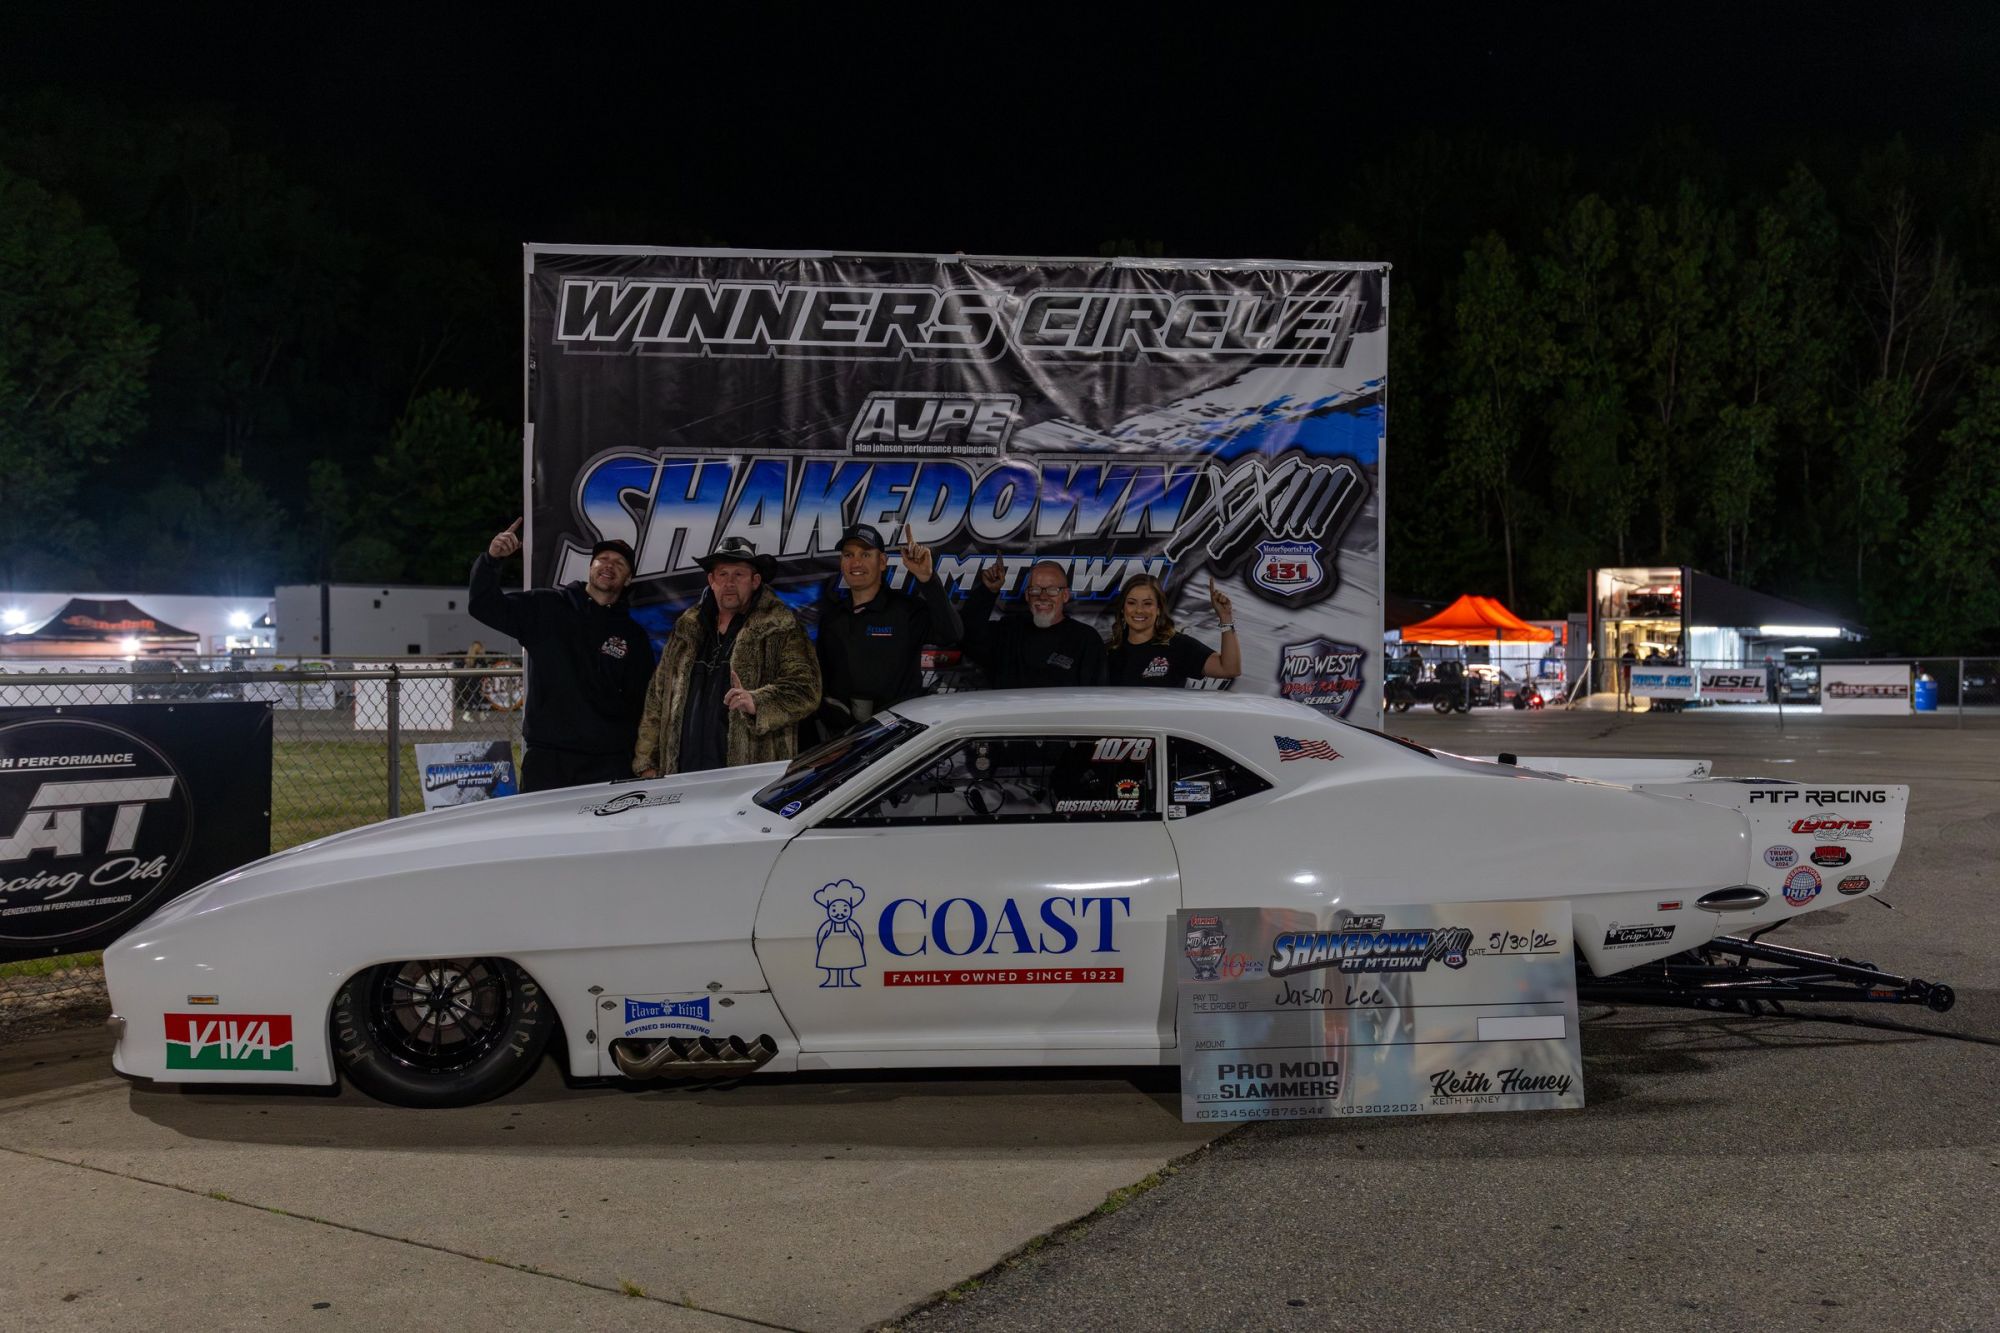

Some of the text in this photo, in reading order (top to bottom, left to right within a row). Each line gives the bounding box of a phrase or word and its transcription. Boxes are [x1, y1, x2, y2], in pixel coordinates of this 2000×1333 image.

[556, 278, 1352, 356] WINNERS CIRCLE
[854, 398, 1011, 443] AJPE
[855, 444, 998, 455] alan johnson performance engineering
[556, 454, 1198, 588] SHAKEDOWN
[1266, 563, 1308, 580] 131
[1280, 653, 1362, 679] MID-WEST
[1702, 675, 1765, 688] JESEL
[1831, 684, 1908, 695] KINETIC
[1303, 695, 1344, 705] SERIES
[1091, 737, 1153, 762] 1078
[17, 753, 134, 768] PERFORMANCE
[1750, 790, 1799, 803] PTP
[1055, 799, 1139, 812] GUSTAFSON/LEE
[0, 855, 167, 900] cing Oils
[1784, 866, 1822, 887] INTERNATIONAL
[1785, 888, 1817, 898] IHRA
[2, 904, 42, 917] GENERATION
[51, 899, 96, 910] PERFORMANCE
[96, 894, 132, 906] LUBRICANTS
[877, 896, 1131, 957] COAST
[1344, 917, 1384, 929] AJPE
[1489, 929, 1557, 953] 5/30/26
[1272, 931, 1430, 971] SHAKEDOWN
[1468, 948, 1487, 956] DATE
[1342, 957, 1423, 968] AT M'TOWN
[892, 970, 1117, 984] FAMILY OWNED SINCE 1922
[1193, 993, 1219, 1002] PAY TO
[1275, 981, 1384, 1006] Jason Lee
[628, 1001, 704, 1019] Flavor King
[1193, 1001, 1249, 1010] THE ORDER OF
[625, 1023, 711, 1037] REFINED SHORTENING
[188, 1020, 271, 1060] VIVA
[1195, 1040, 1226, 1049] AMOUNT
[1218, 1060, 1340, 1080] PRO MOD
[1220, 1082, 1339, 1099] SLAMMERS
[1430, 1068, 1573, 1097] Keith Haney
[1432, 1095, 1501, 1106] KEITH HANEY
